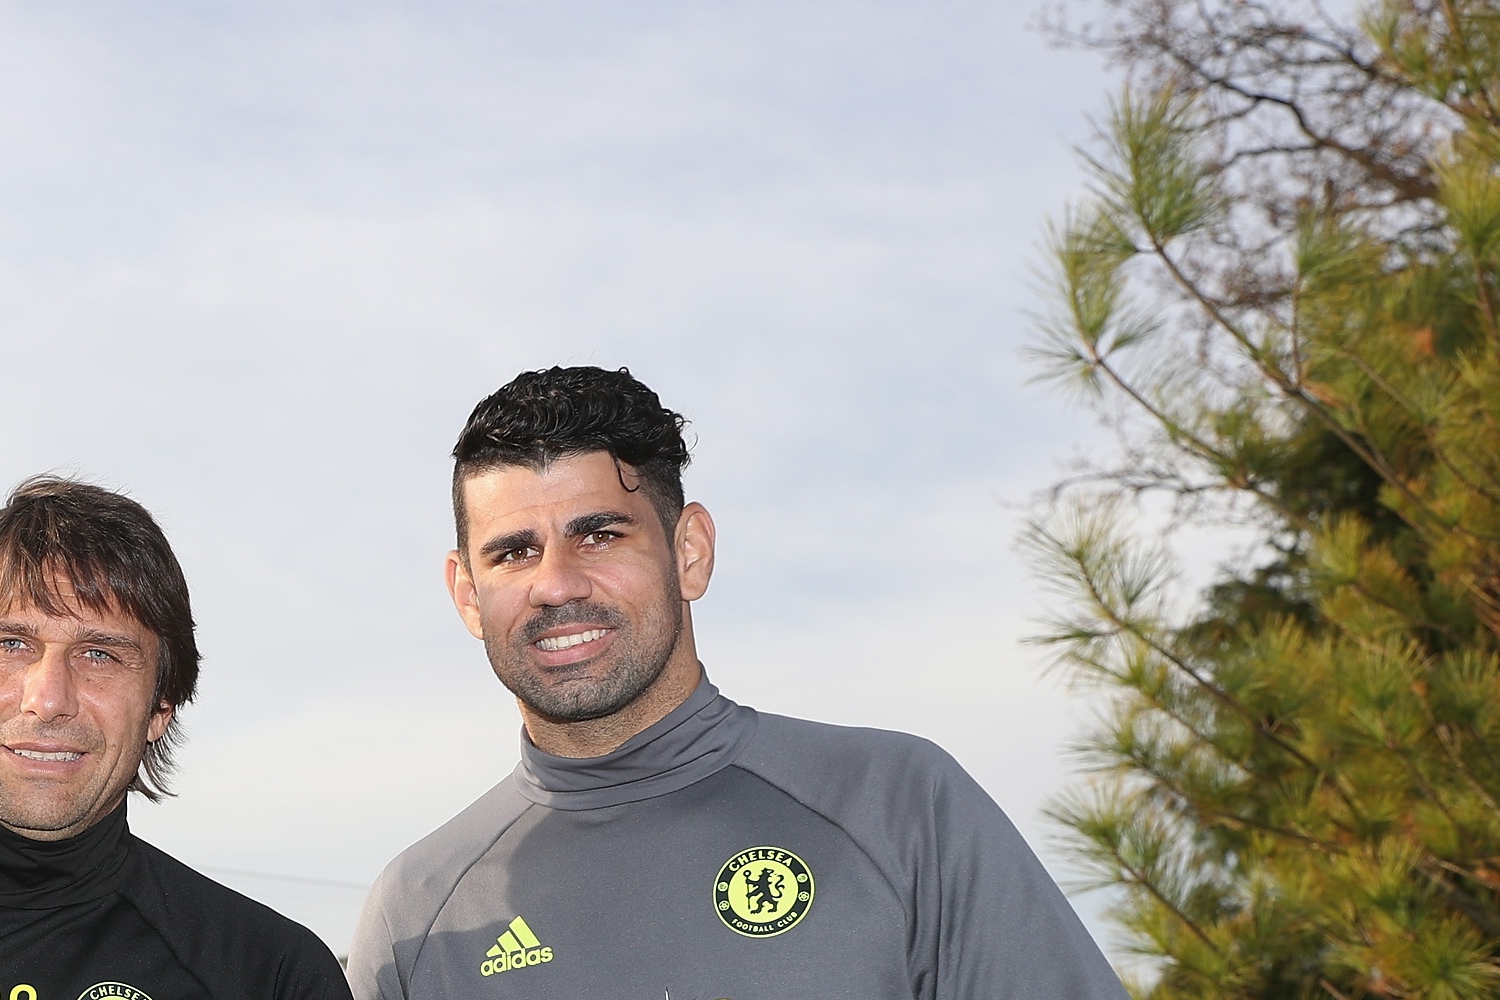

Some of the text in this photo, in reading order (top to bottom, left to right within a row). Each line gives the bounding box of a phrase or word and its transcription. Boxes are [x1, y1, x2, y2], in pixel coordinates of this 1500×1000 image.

[728, 850, 793, 872] CHELSEA
[731, 911, 798, 933] FOOTBALL CLUB
[480, 946, 554, 977] adidas
